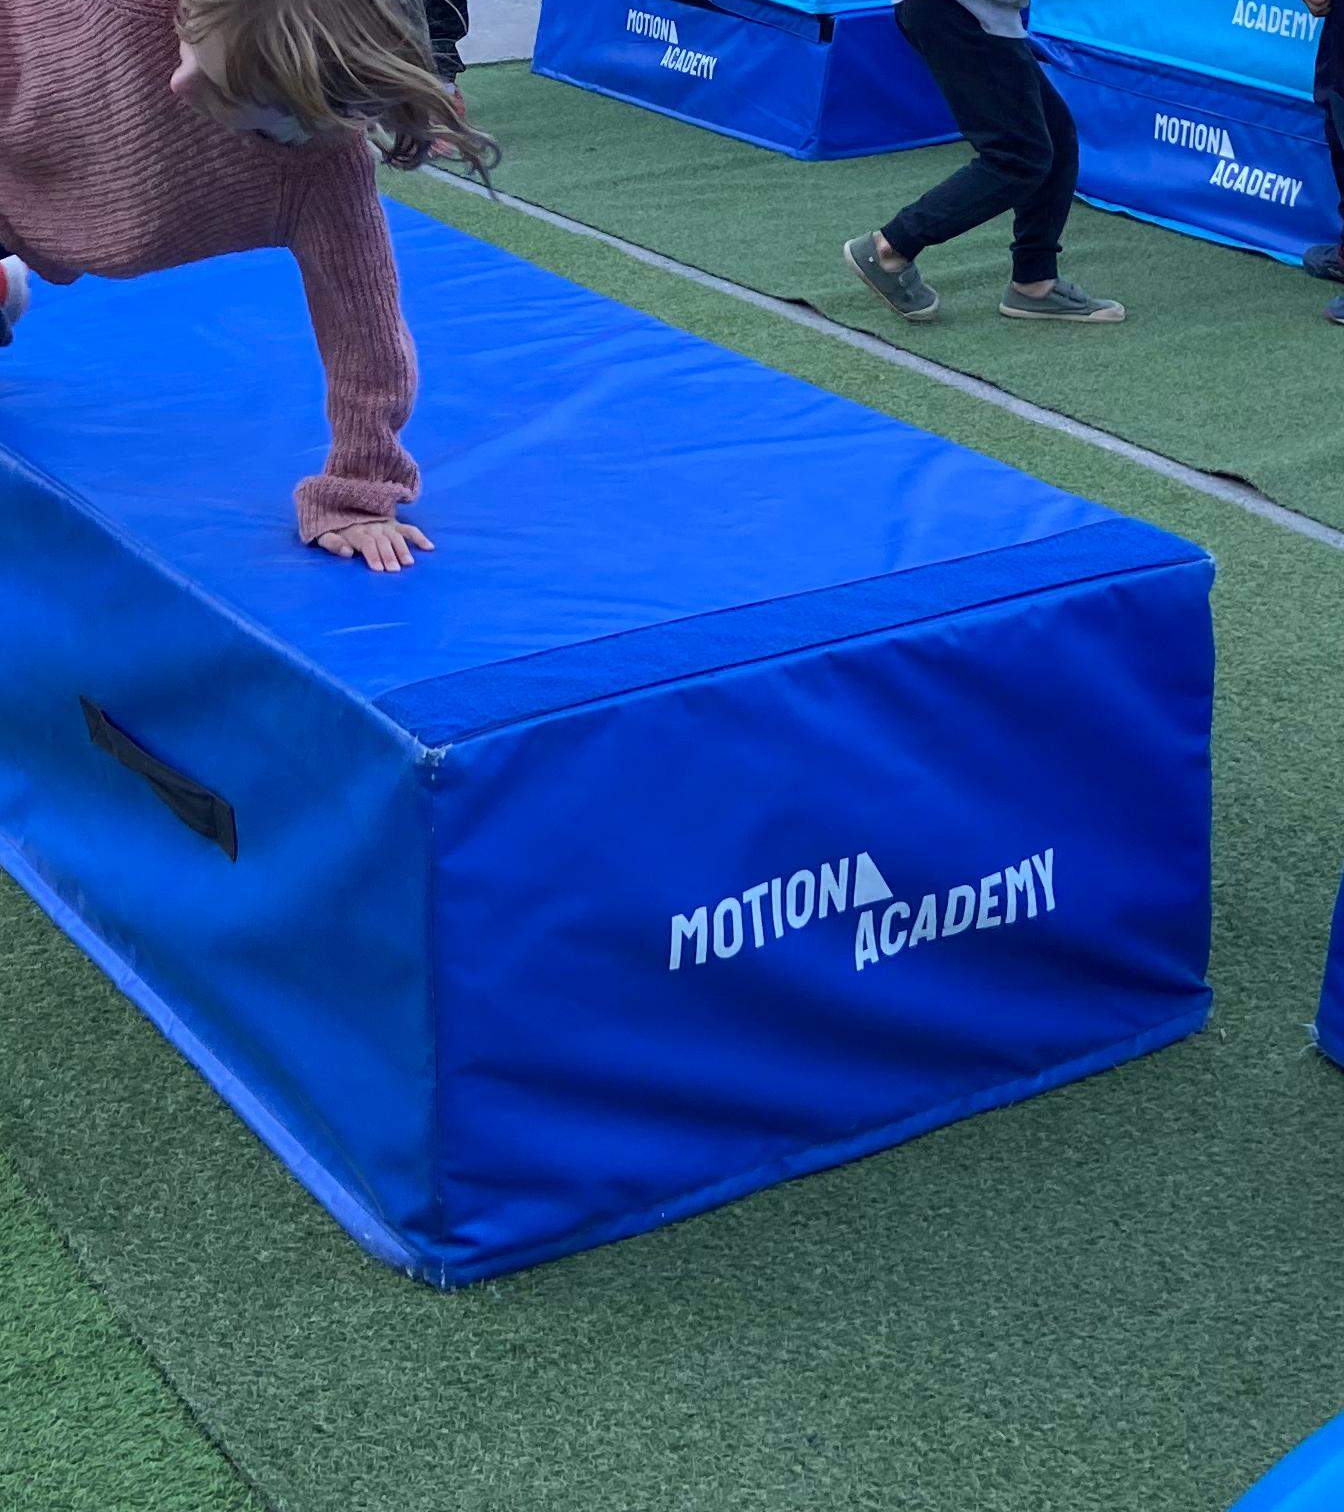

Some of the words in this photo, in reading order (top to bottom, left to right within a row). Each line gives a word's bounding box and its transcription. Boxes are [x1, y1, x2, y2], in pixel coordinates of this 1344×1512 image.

[626, 8, 670, 41] MOTION
[1232, 0, 1319, 42] ACADEMY
[660, 45, 717, 80] ACADEMY
[1154, 112, 1222, 155] MOTION
[1209, 159, 1303, 207] ACADEMY
[669, 857, 850, 971] MOTION
[855, 847, 1056, 971] ACADEMY
